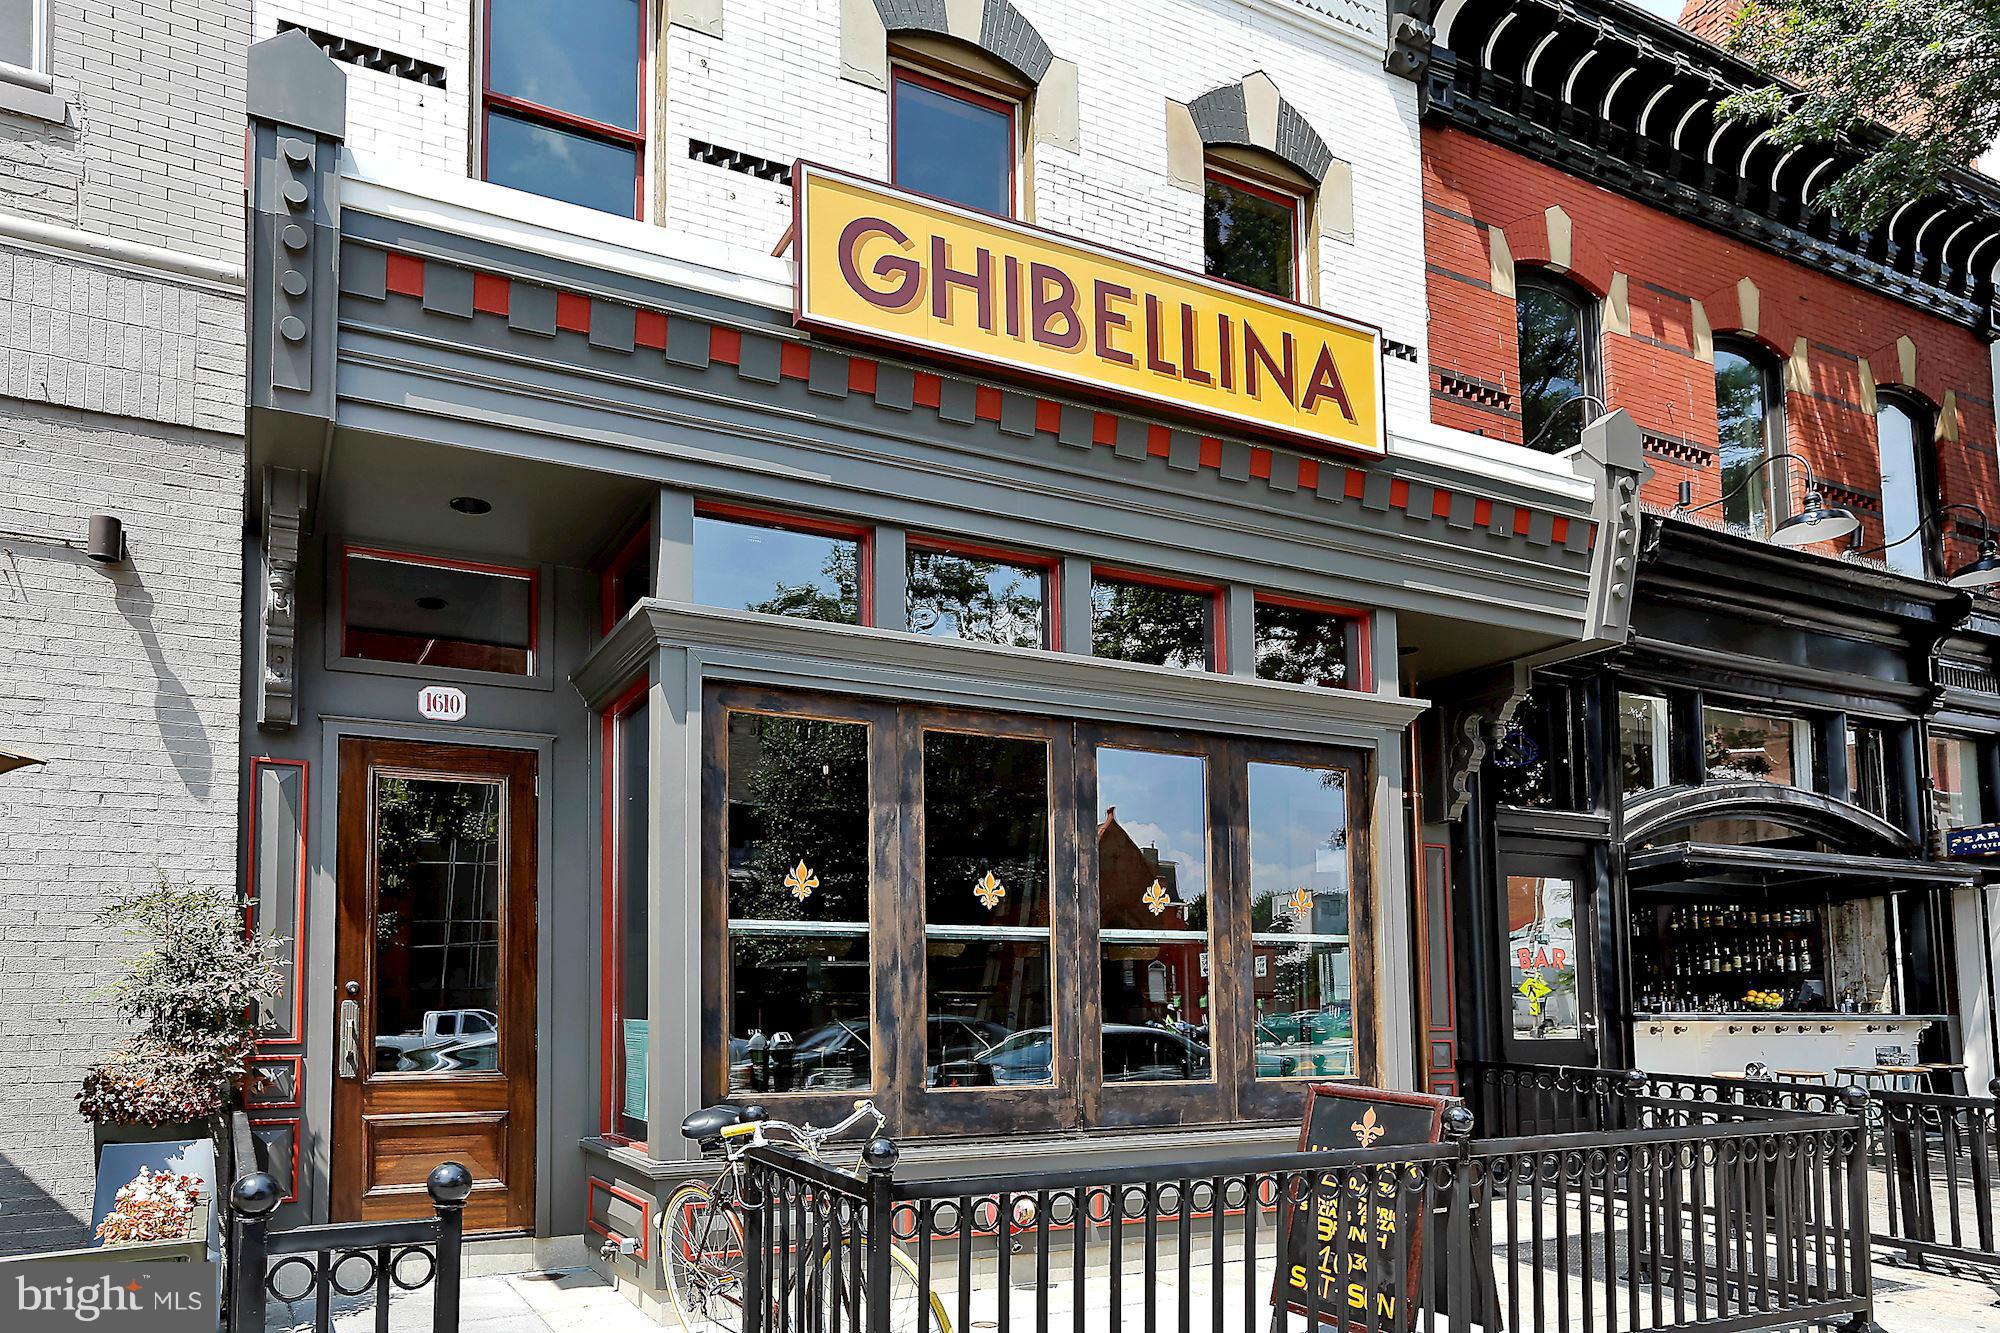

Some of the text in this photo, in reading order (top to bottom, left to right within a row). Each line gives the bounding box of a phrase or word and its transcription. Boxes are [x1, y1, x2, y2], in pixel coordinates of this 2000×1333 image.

[837, 216, 1357, 423] GHIBELLINA
[426, 692, 461, 714] 1610
[1517, 947, 1566, 970] BAR
[1289, 1264, 1396, 1320] ST SN
